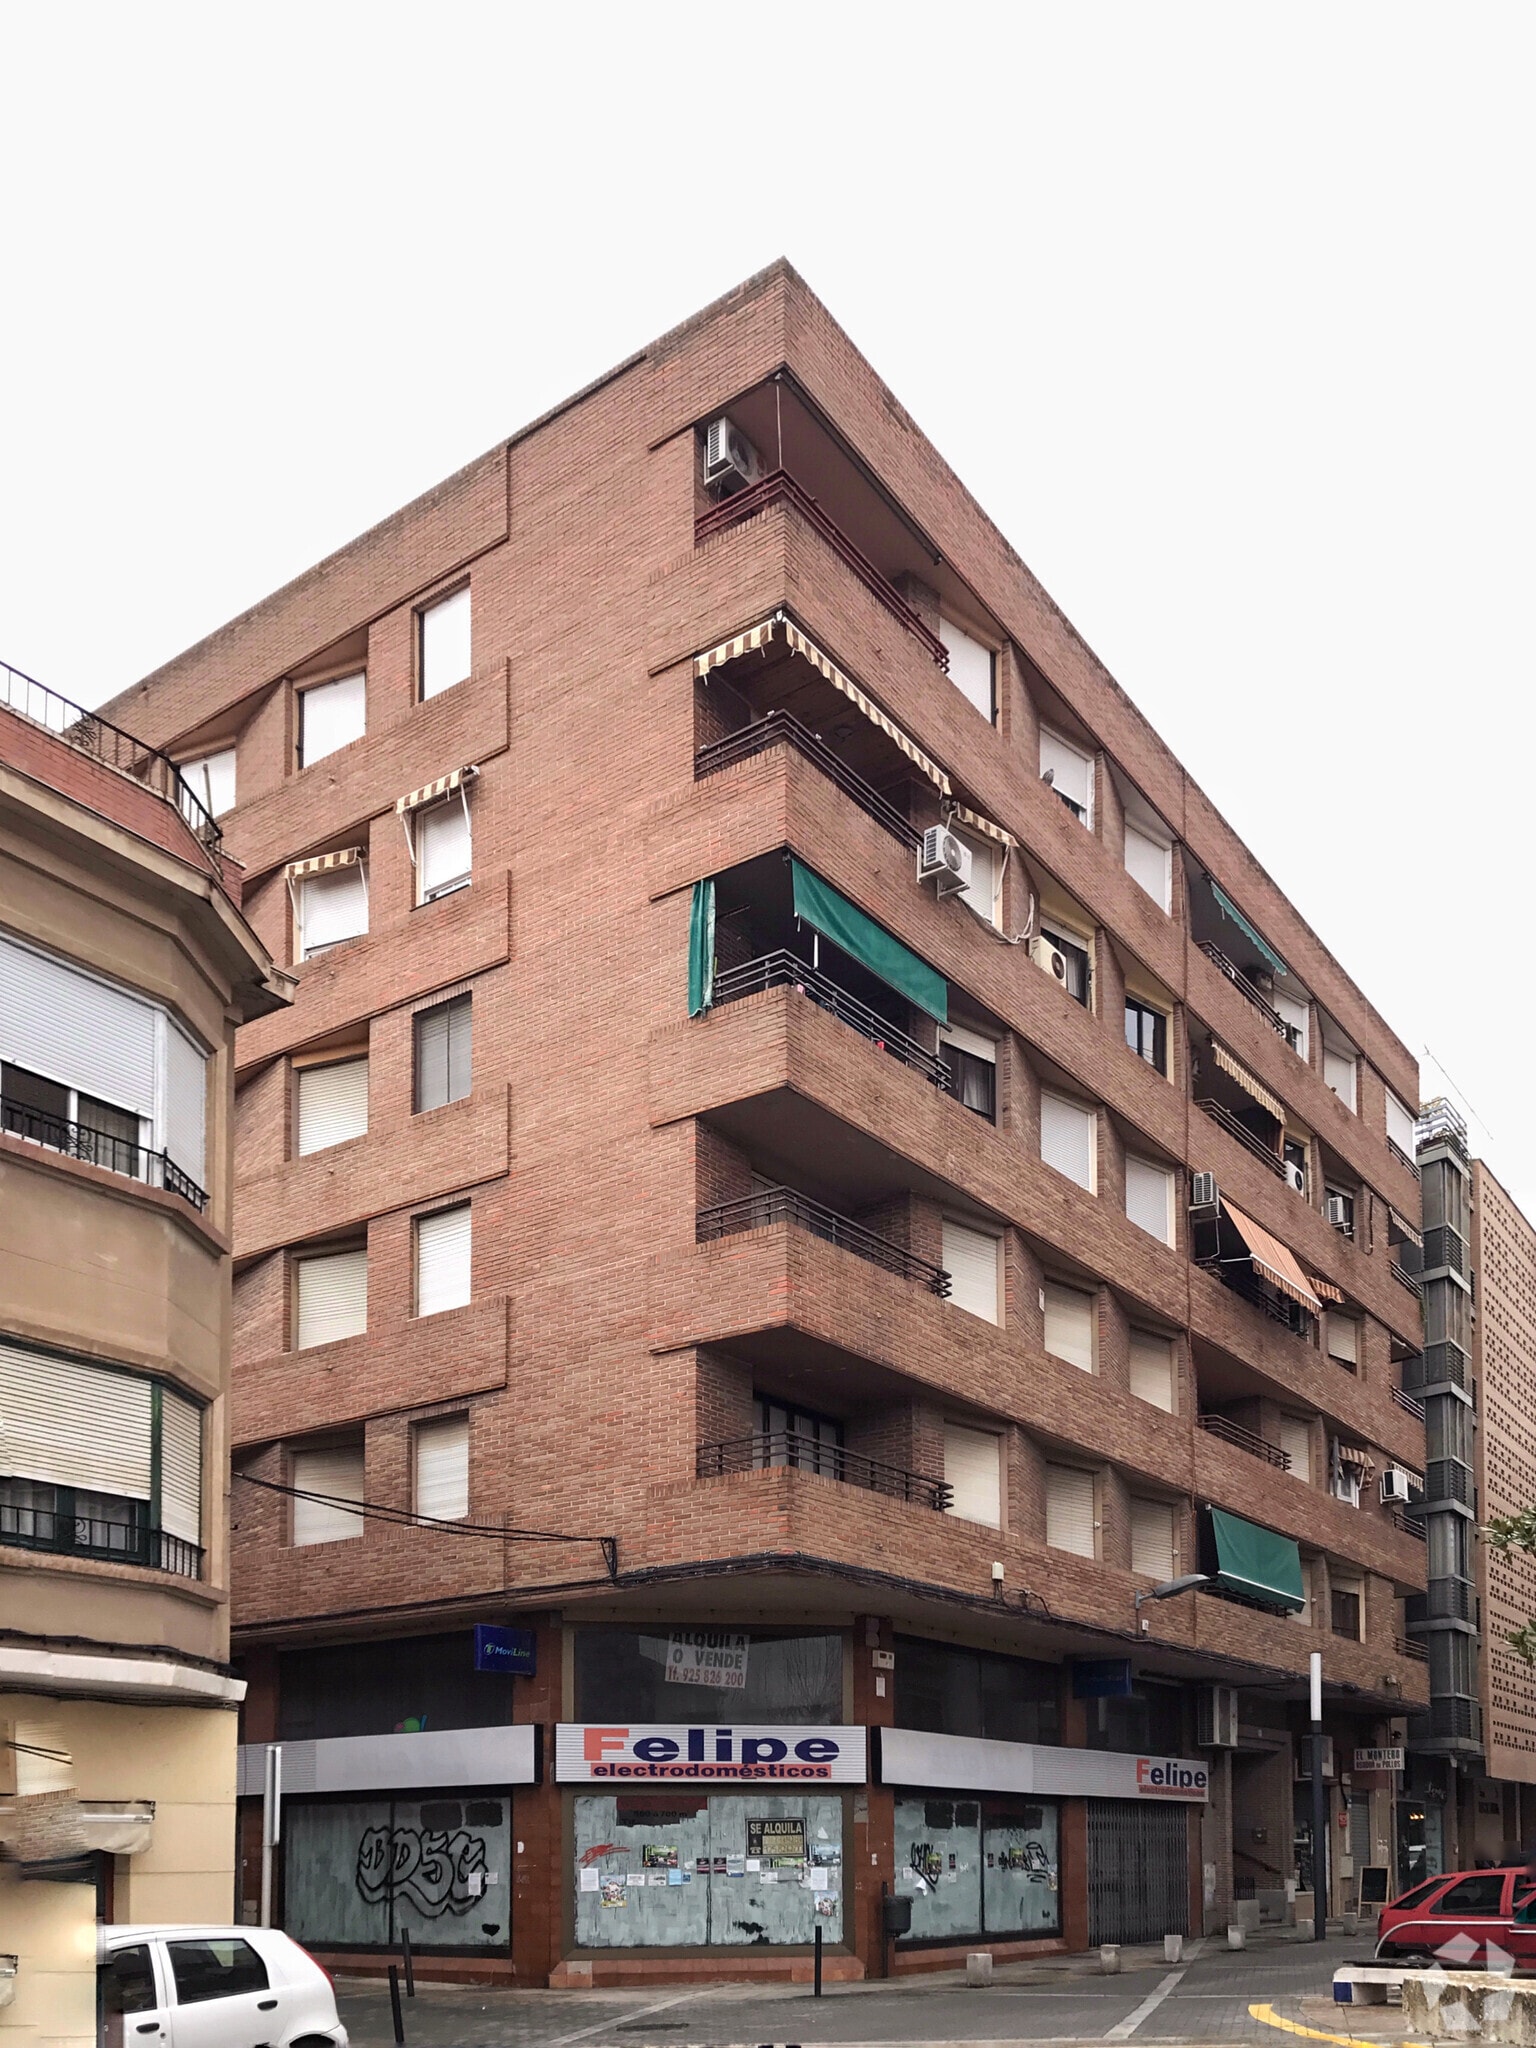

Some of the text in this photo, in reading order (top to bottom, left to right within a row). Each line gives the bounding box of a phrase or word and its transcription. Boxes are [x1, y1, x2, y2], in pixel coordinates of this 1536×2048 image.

[672, 1632, 746, 1651] ALQUILA
[494, 1646, 530, 1658] MoviLine
[672, 1648, 743, 1670] O VENDE
[682, 1667, 701, 1683] 925
[703, 1669, 721, 1684] 826
[725, 1672, 744, 1686] 200
[584, 1728, 840, 1764] Felipe
[1355, 1750, 1363, 1761] EL
[593, 1763, 829, 1779] electrodomésticos
[1382, 1760, 1401, 1769] POLLOS
[1136, 1758, 1207, 1789] Felipe
[750, 1822, 803, 1835] SE ALQUILA
